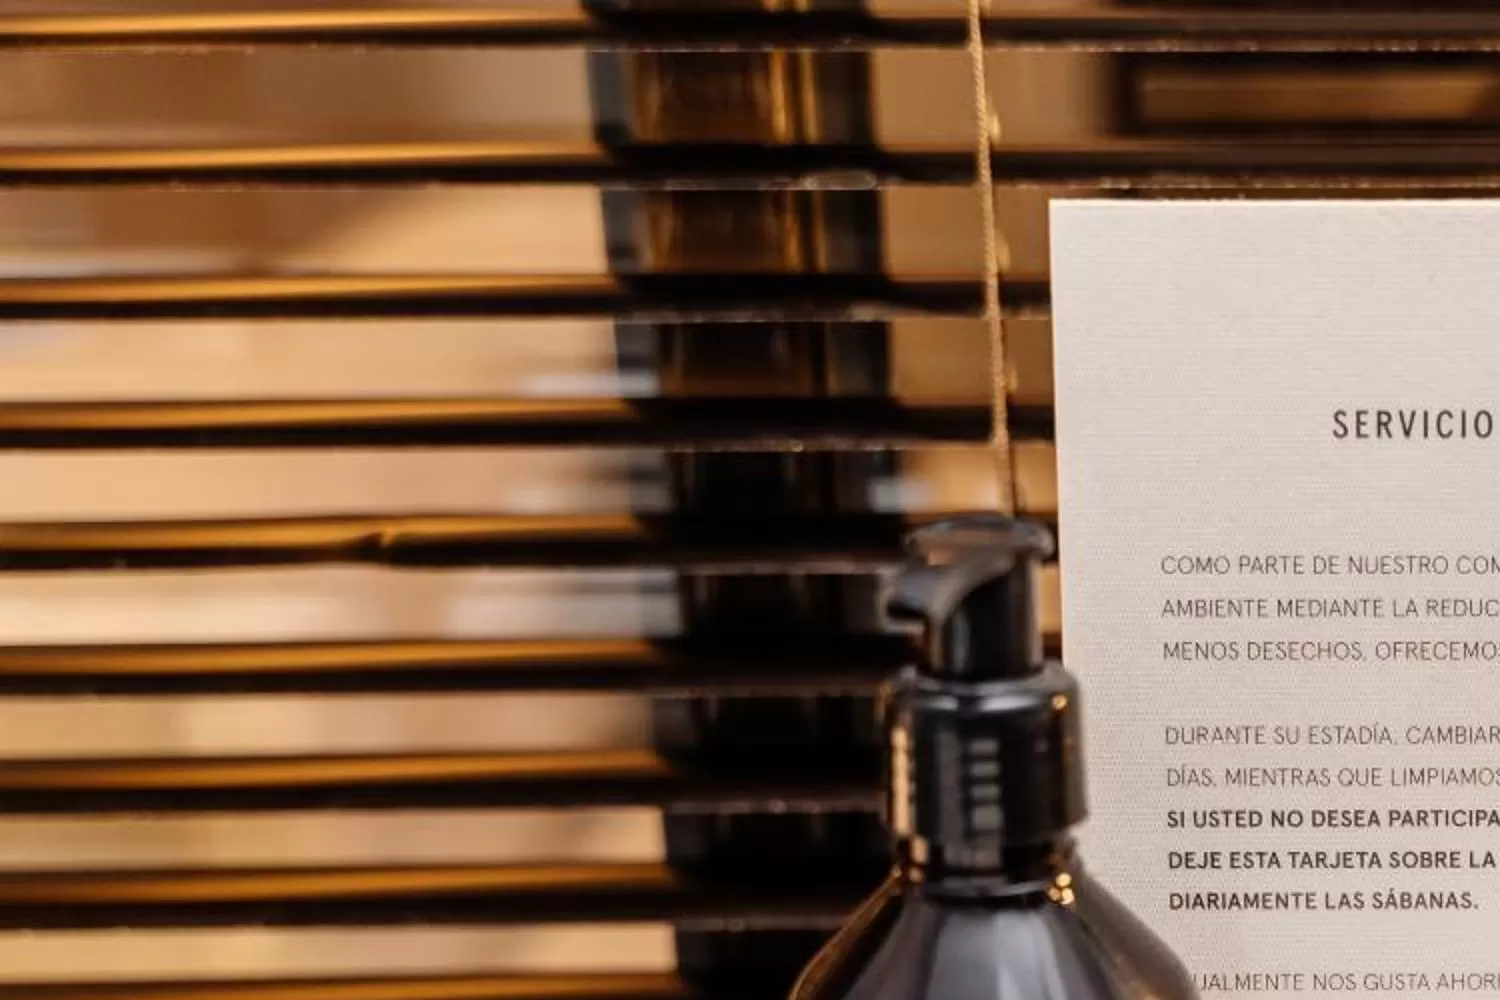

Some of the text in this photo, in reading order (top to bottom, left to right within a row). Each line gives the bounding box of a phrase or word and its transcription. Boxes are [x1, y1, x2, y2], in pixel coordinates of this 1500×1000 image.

[1332, 409, 1494, 439] SERVICIO
[1160, 555, 1231, 575] COMO
[1238, 554, 1305, 575] PARTE
[1312, 555, 1339, 575] DE
[1347, 554, 1449, 575] NUESTRO
[1161, 598, 1268, 618] AMBIENTE
[1276, 598, 1383, 618] MEDIANTE
[1392, 598, 1419, 618] LA
[1163, 640, 1240, 662] MENOS
[1164, 725, 1265, 746] DURANTE
[1273, 725, 1300, 745] SU
[1224, 767, 1331, 787] MIENTRAS
[1337, 767, 1381, 787] QUE
[1167, 810, 1185, 829] SI
[1192, 809, 1263, 829] USTED
[1270, 809, 1304, 828] NO
[1311, 809, 1381, 828] DESEA
[1168, 851, 1222, 870] DEJE
[1229, 851, 1282, 870] ESTA
[1287, 850, 1382, 869] TARJETA
[1389, 850, 1461, 869] SOBRE
[1469, 851, 1497, 869] LA
[1169, 888, 1478, 911] DIARIAMENTE LAS SÁBANAS.
[1193, 972, 1304, 992] UALMENTE
[1312, 972, 1357, 991] NOS
[1362, 972, 1431, 991] GUSTA
